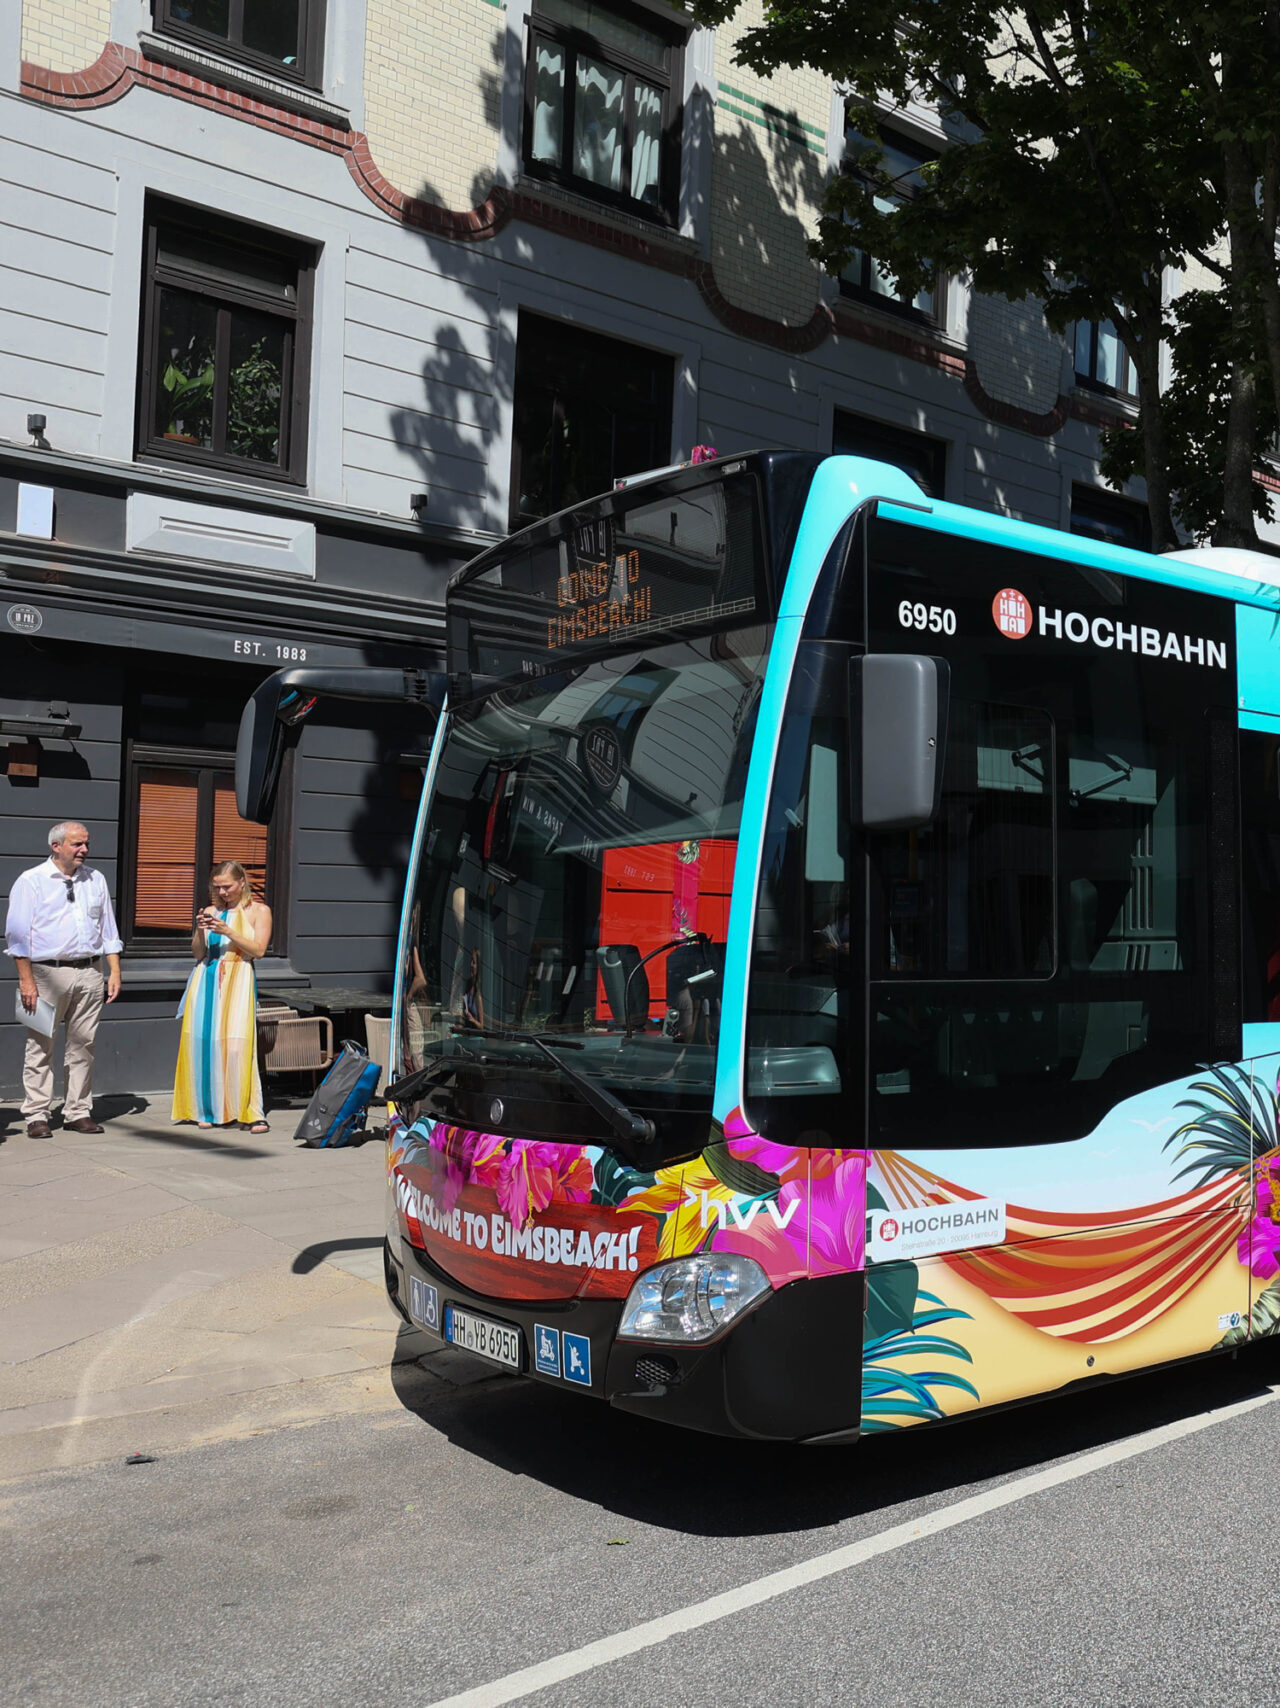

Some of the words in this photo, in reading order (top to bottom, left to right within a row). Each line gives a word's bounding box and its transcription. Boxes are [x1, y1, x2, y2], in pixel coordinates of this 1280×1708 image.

[557, 561, 608, 607] GOING
[616, 550, 640, 587] TO
[547, 586, 651, 649] EIMSBEACH!
[899, 600, 957, 636] 6950
[1038, 605, 1227, 669] HOCHBAHN
[234, 640, 266, 657] EST.
[276, 645, 307, 661] 1983
[396, 1174, 462, 1242] WELCOME
[463, 1211, 489, 1250] TO
[901, 1208, 999, 1235] HOCHBAHN
[491, 1213, 643, 1272] EIMSBEACH!
[453, 1312, 466, 1344] HH
[474, 1321, 487, 1351] YB
[489, 1327, 517, 1363] 6950
